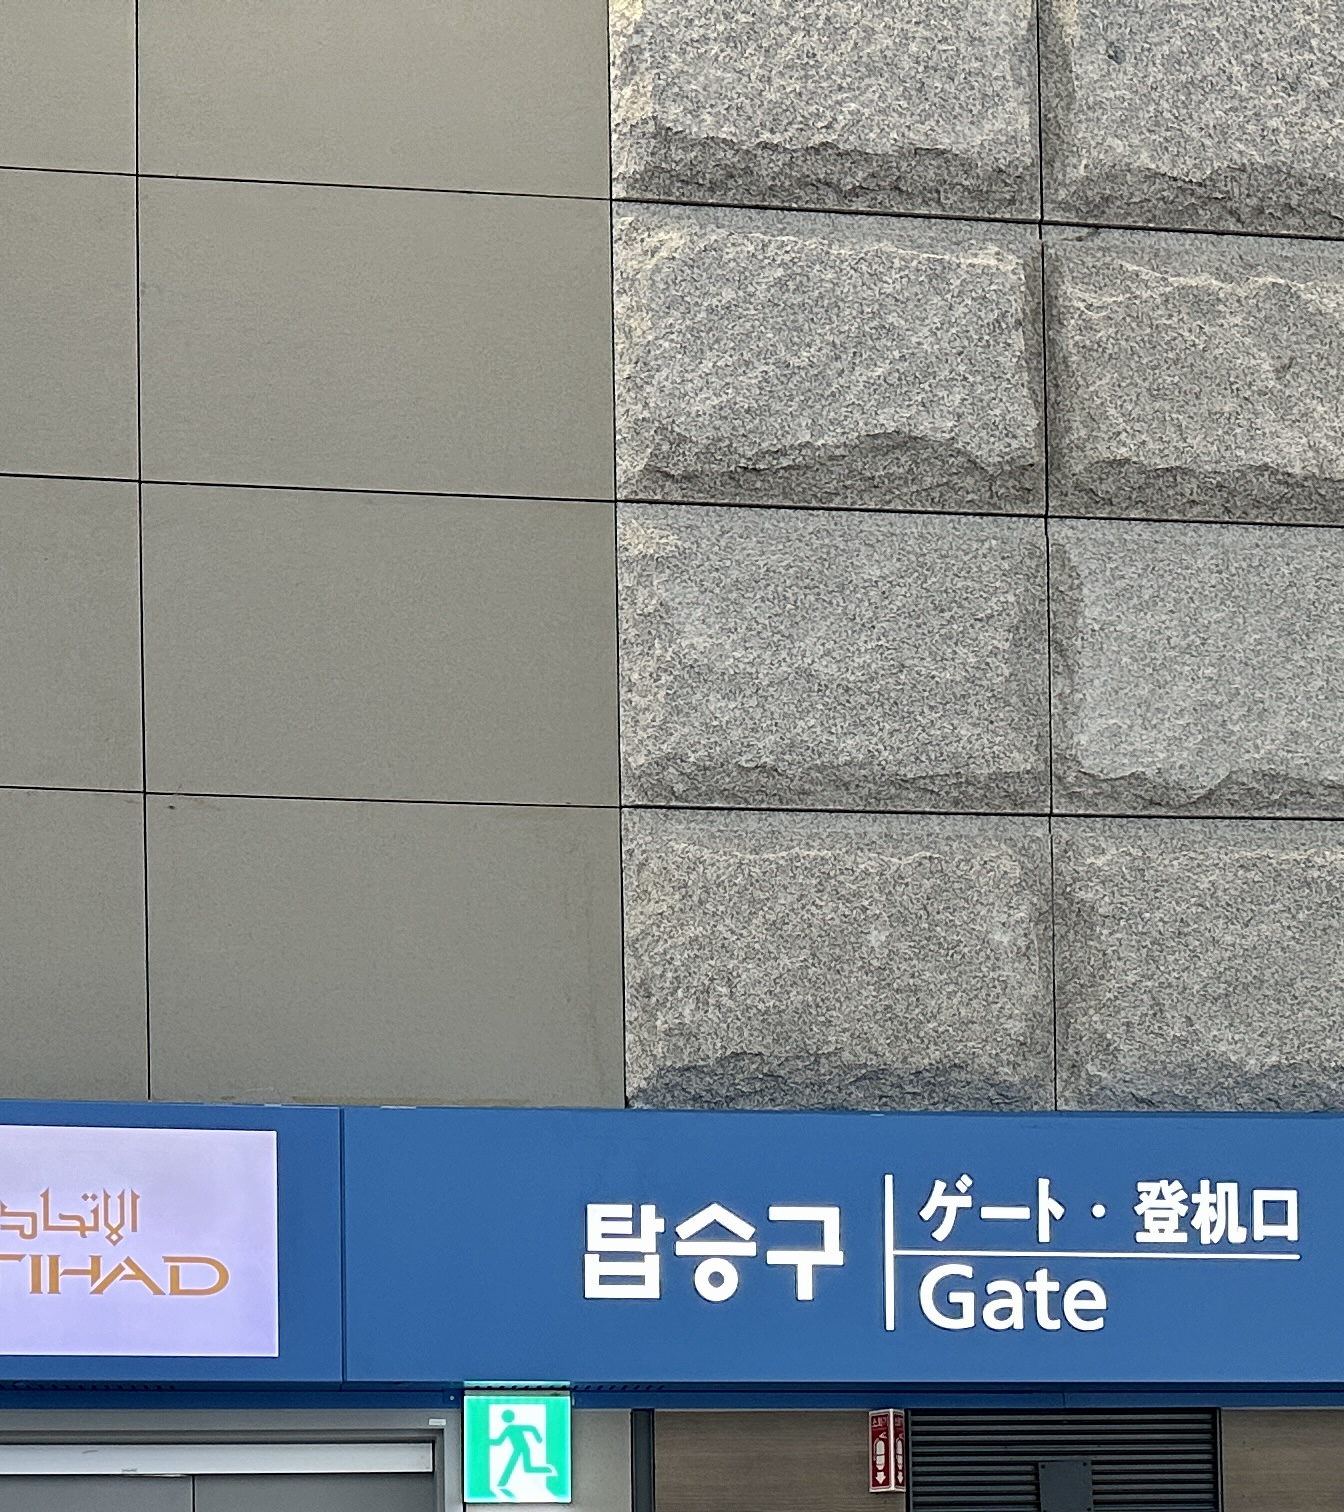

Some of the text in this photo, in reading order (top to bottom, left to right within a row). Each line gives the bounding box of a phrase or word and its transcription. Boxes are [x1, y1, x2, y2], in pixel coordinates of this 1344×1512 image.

[919, 1173, 1065, 1243] ゲート
[1134, 1179, 1299, 1245] 登机口
[583, 1202, 845, 1303] 탑승구
[919, 1263, 1108, 1332] Gate
